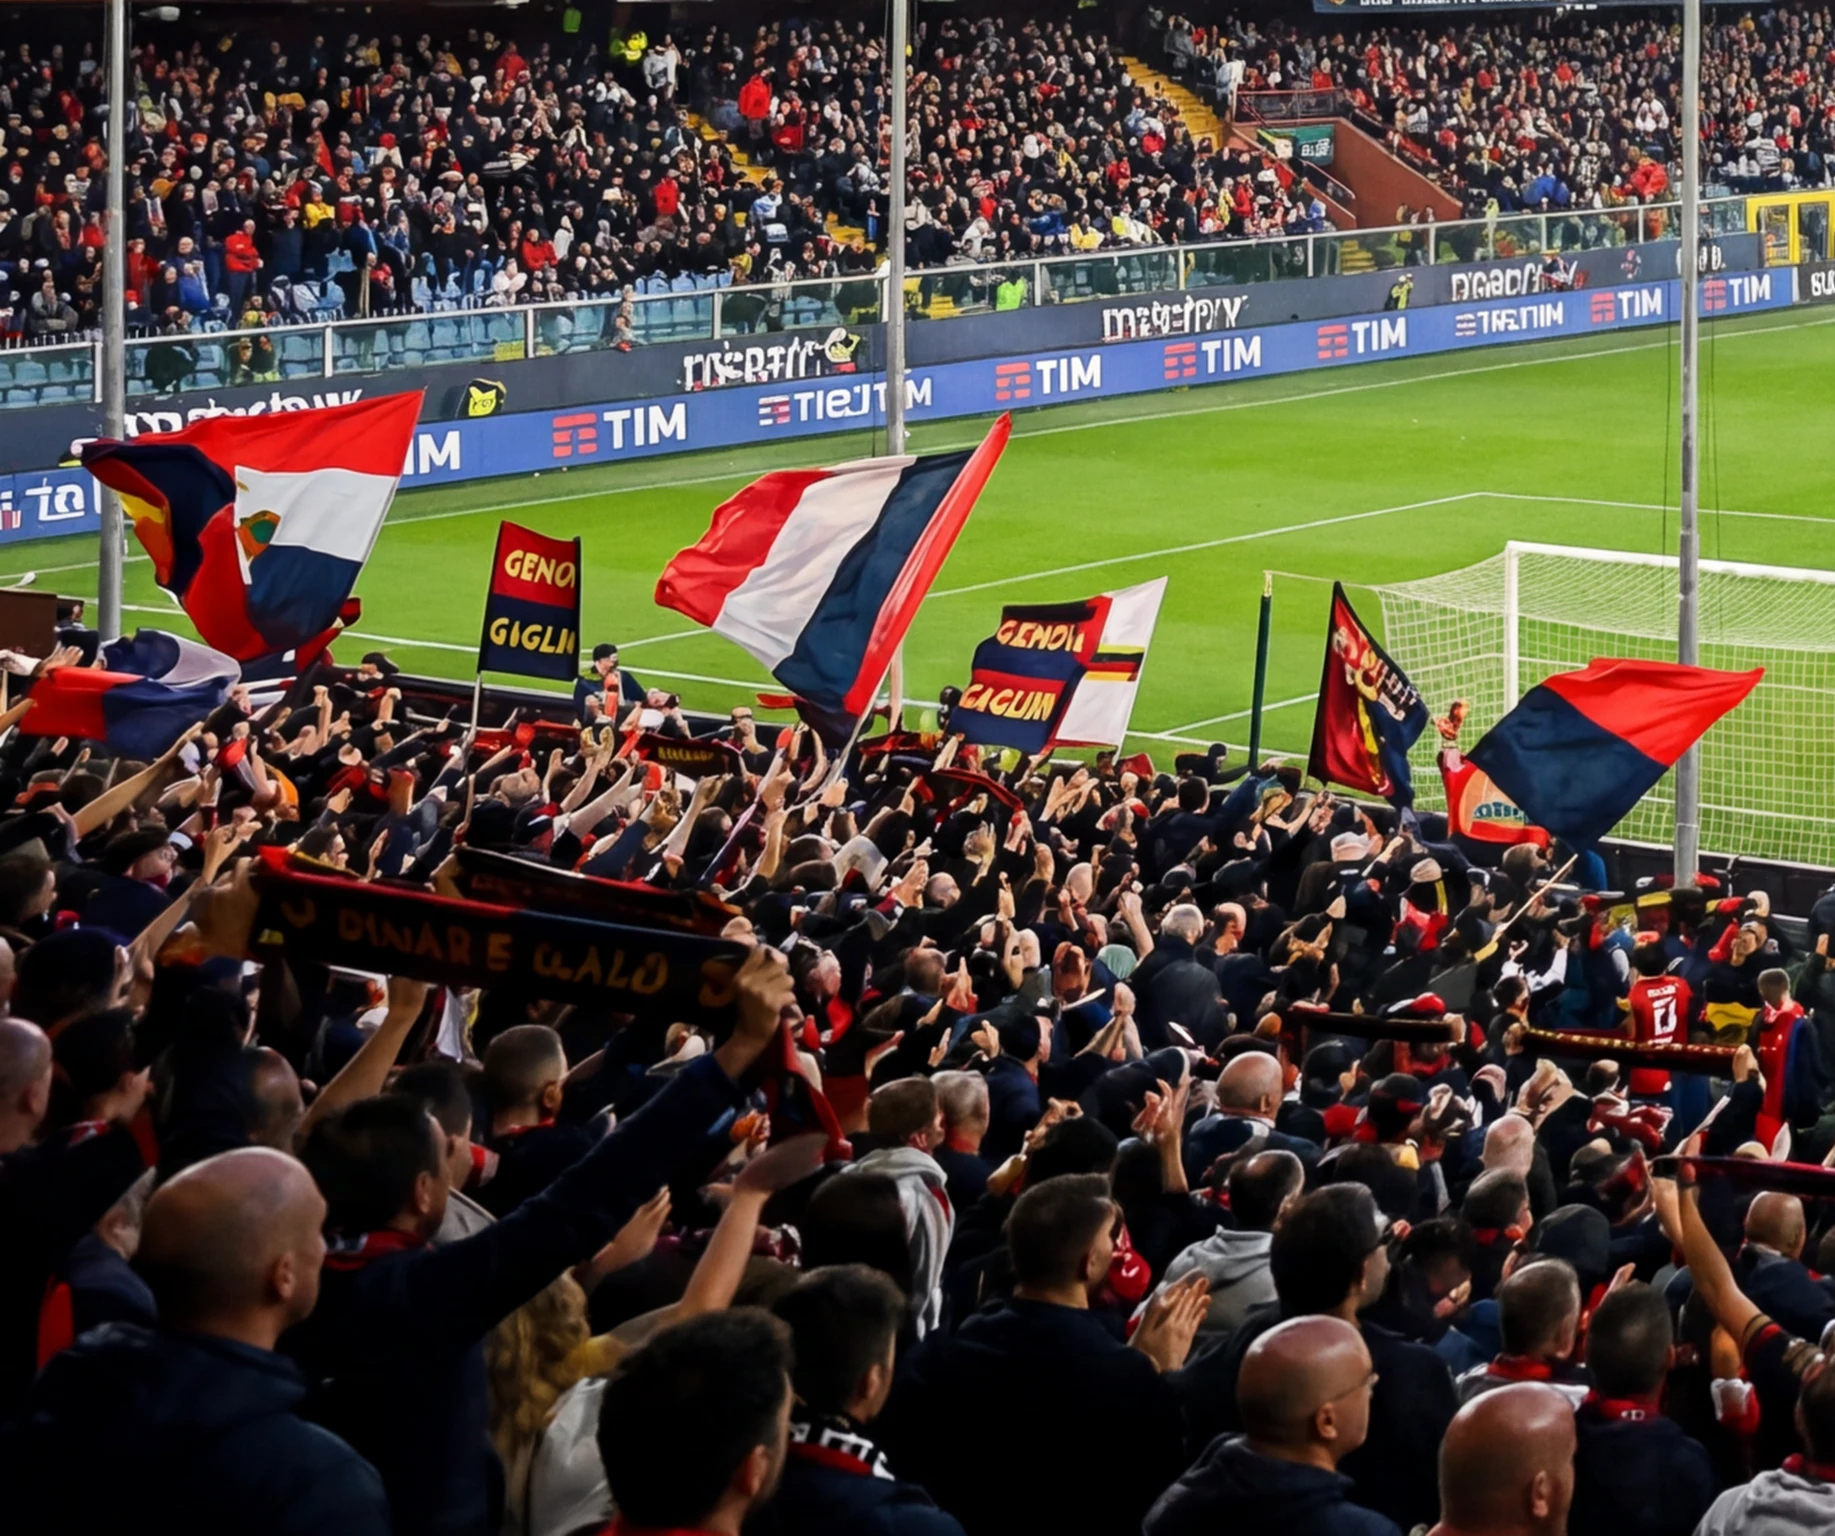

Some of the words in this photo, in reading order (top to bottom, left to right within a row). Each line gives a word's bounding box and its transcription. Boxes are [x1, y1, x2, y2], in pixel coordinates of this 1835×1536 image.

[1618, 288, 1662, 320] TIM
[1728, 274, 1772, 307] TIM
[1351, 317, 1407, 354] TIM
[1201, 336, 1262, 374] TIM
[1036, 355, 1101, 395] TIM
[602, 403, 687, 450] TIM
